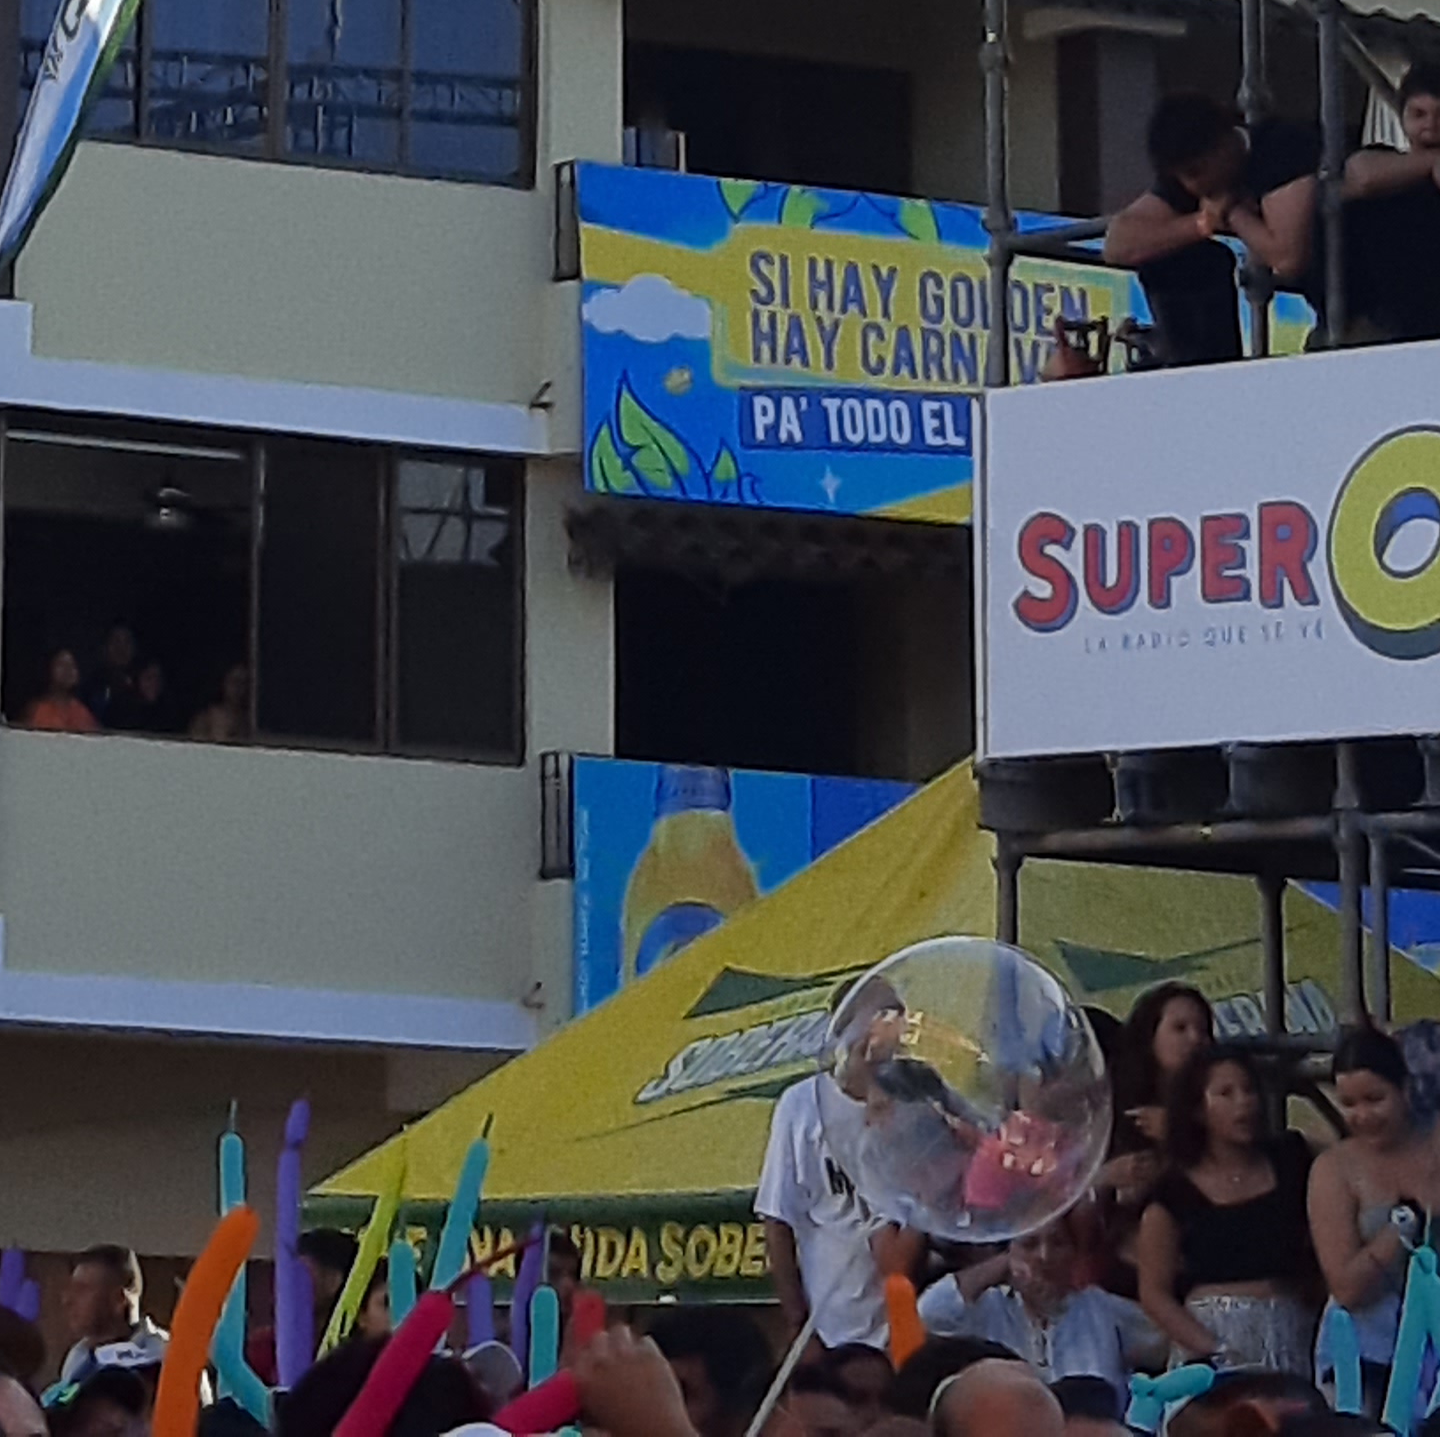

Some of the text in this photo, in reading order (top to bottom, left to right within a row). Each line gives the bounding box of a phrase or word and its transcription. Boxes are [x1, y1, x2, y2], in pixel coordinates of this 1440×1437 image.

[749, 250, 790, 311] SI
[808, 253, 898, 321] HAY
[751, 308, 841, 372] HAY
[752, 395, 967, 447] PA' TODO EL
[1013, 501, 1320, 633] SUPER
